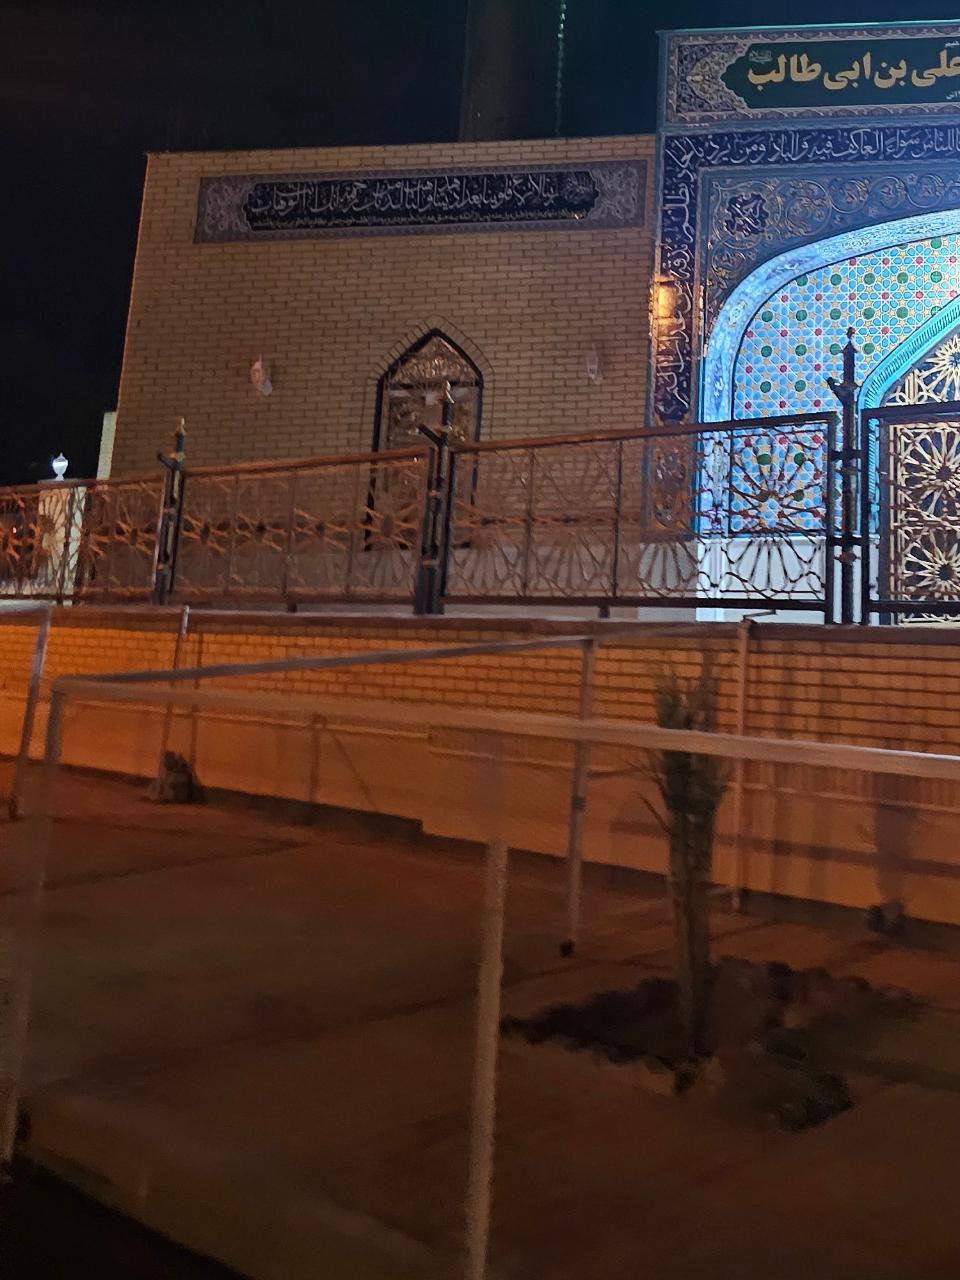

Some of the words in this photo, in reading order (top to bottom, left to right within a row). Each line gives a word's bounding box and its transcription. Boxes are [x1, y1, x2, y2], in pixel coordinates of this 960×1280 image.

[747, 53, 823, 92] طالب
[822, 51, 872, 91] ابی
[873, 59, 907, 89] بن
